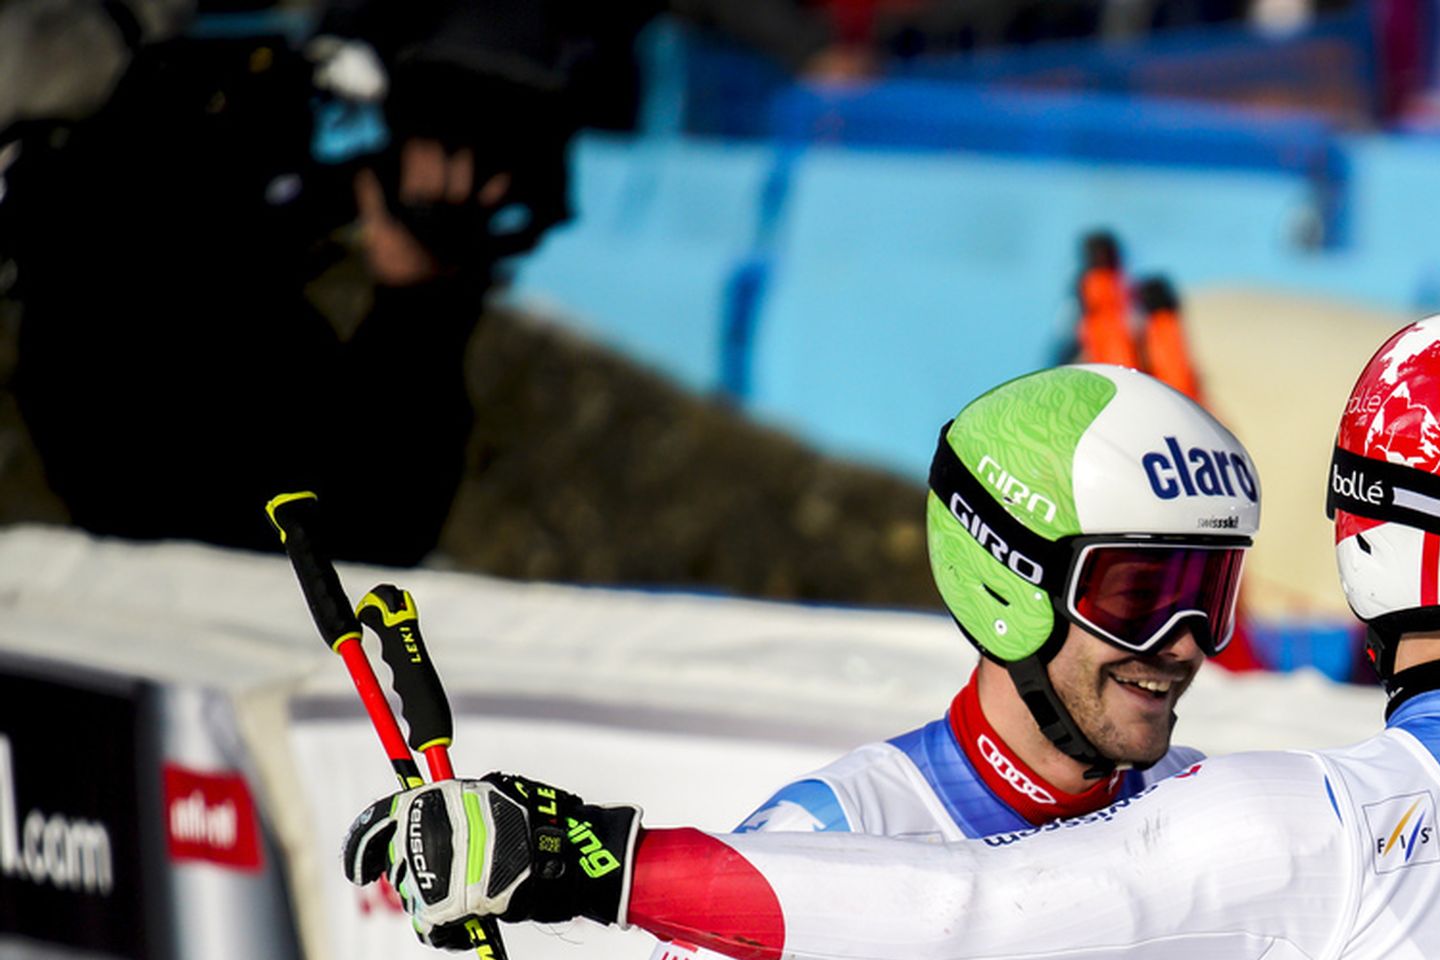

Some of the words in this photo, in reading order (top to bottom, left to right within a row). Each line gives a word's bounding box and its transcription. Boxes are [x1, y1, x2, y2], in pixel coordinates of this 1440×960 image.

[977, 455, 1056, 523] GIRO
[1142, 436, 1258, 502] claro
[1332, 464, 1384, 505] bollé
[950, 492, 1043, 584] GIRO
[399, 626, 421, 662] LEKI
